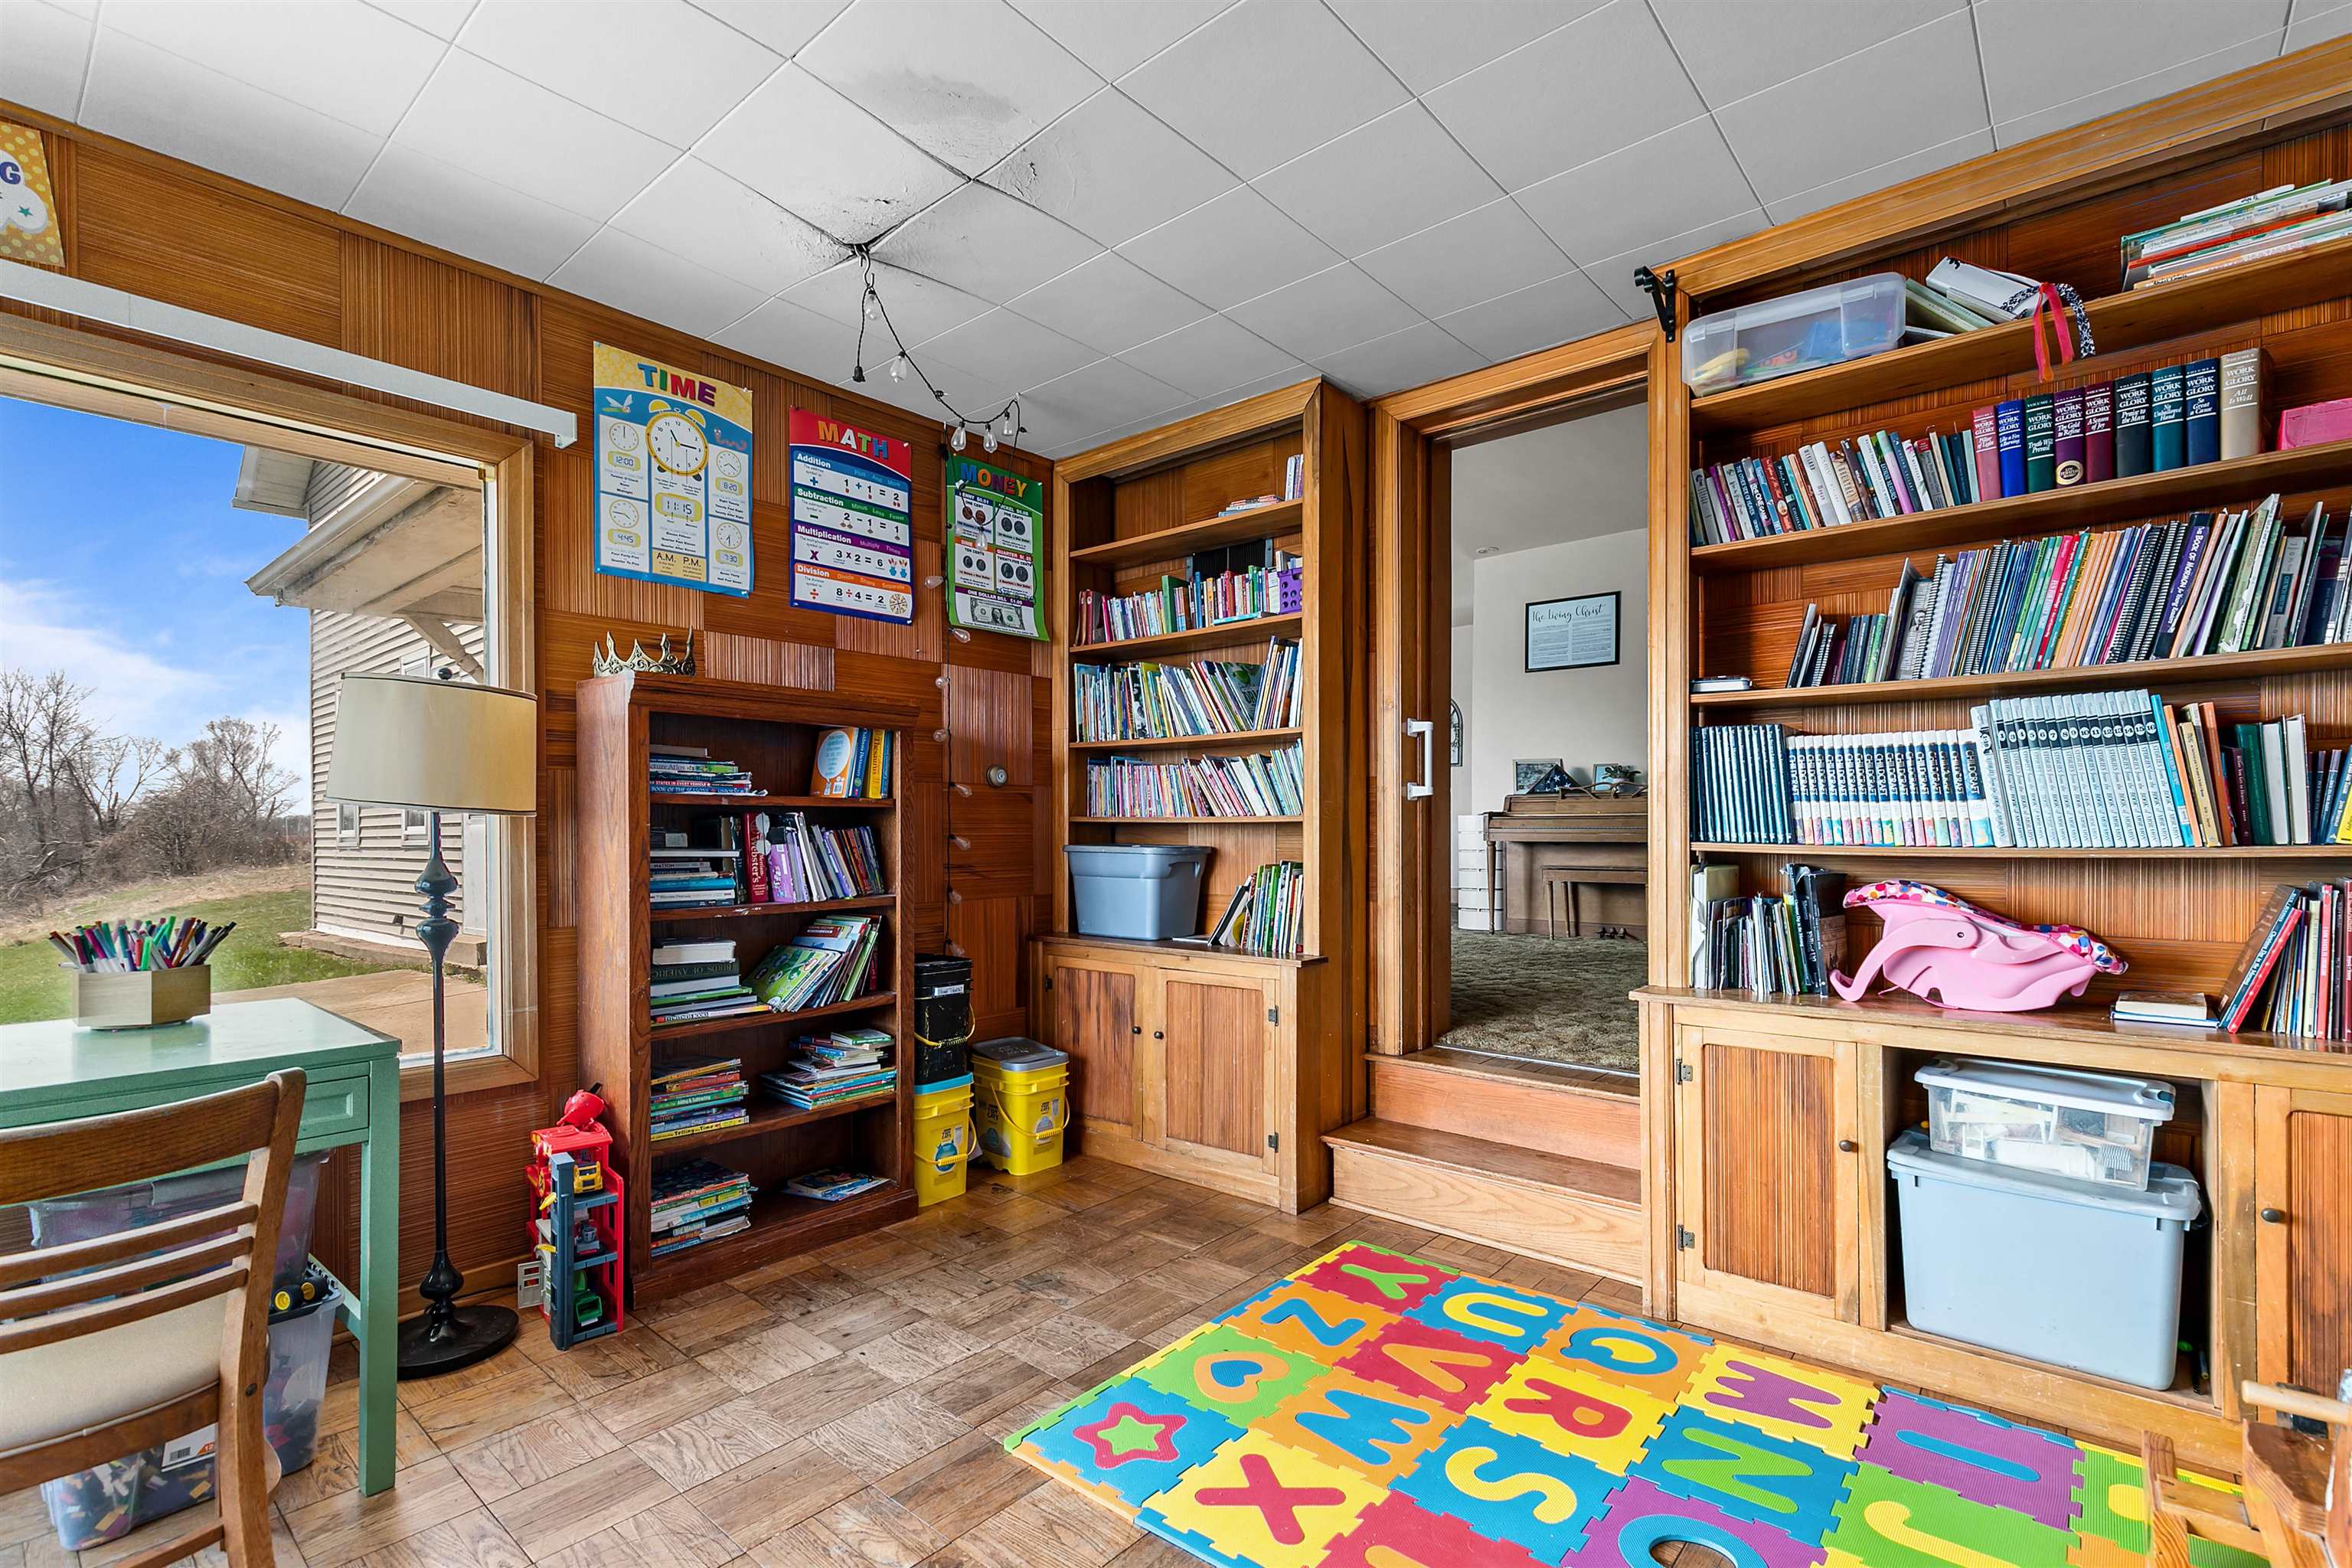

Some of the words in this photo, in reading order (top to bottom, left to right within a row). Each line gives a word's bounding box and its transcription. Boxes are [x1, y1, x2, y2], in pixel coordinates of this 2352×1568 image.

[2226, 366, 2255, 377] WORK
[637, 363, 716, 407] TIME
[2187, 376, 2214, 387] WORK
[2225, 374, 2256, 386] GLORY
[2154, 382, 2181, 393] WORK
[2186, 384, 2216, 396] GLORY
[2120, 389, 2147, 400] WORK
[2153, 390, 2182, 402] GLORY
[2236, 394, 2253, 402] Well
[2086, 398, 2110, 408] WORK
[2119, 397, 2148, 408] GLORY
[2056, 404, 2082, 414] WORK
[2086, 405, 2110, 415] GLORY
[2122, 410, 2139, 418] Praise
[1998, 416, 2019, 424] WORK
[2028, 413, 2053, 423] WORK
[2055, 411, 2082, 422] GLORY
[1975, 420, 1994, 429] WORK
[1998, 423, 2020, 433] GLORY
[2027, 422, 2053, 431] GLORY
[1975, 427, 1994, 436] GLORY
[2063, 428, 2081, 436] Refine
[818, 420, 889, 459] MATH
[2028, 439, 2043, 449] Truth
[2032, 445, 2050, 453] Prevail
[616, 456, 634, 466] 12:00
[796, 453, 831, 469] Addition
[844, 479, 849, 487] 1
[961, 462, 1027, 498] MONEY
[724, 482, 737, 492] 8:20
[797, 488, 844, 506] Subtraction
[667, 501, 692, 514] 11:15
[618, 534, 634, 544] 4:45
[797, 525, 851, 544] Multiplication
[860, 541, 880, 550] Multiply
[886, 545, 901, 555] Times
[656, 552, 677, 563] A.M.
[683, 557, 701, 567] P.M.
[724, 554, 737, 564] 7:30
[836, 550, 842, 558] 3
[997, 549, 1018, 558] QUARTER
[797, 565, 830, 577] Division
[978, 591, 996, 599] DOLLAR
[1575, 603, 1603, 617] Christ
[873, 737, 881, 775] Thesaurus
[1788, 755, 1799, 795] CHILDCRAFT
[1808, 754, 1818, 795] CHILDCRAFT
[1838, 754, 1847, 796] CHILDCRAFT
[1876, 753, 1887, 796] CHILDCRAFT
[1897, 753, 1908, 795] CHILDCRAFT
[1916, 753, 1929, 795] CHILDCRAFT
[1966, 750, 1980, 794] CHILDCRAFT
[751, 832, 761, 883] Webster's
[1340, 1264, 1429, 1300] Y
[1443, 1292, 1548, 1337] U
[1560, 1327, 1678, 1375] Q
[1381, 1342, 1491, 1393] V
[1503, 1378, 1632, 1439] R
[1446, 1446, 1576, 1524] S
[1195, 1454, 1345, 1545] X
